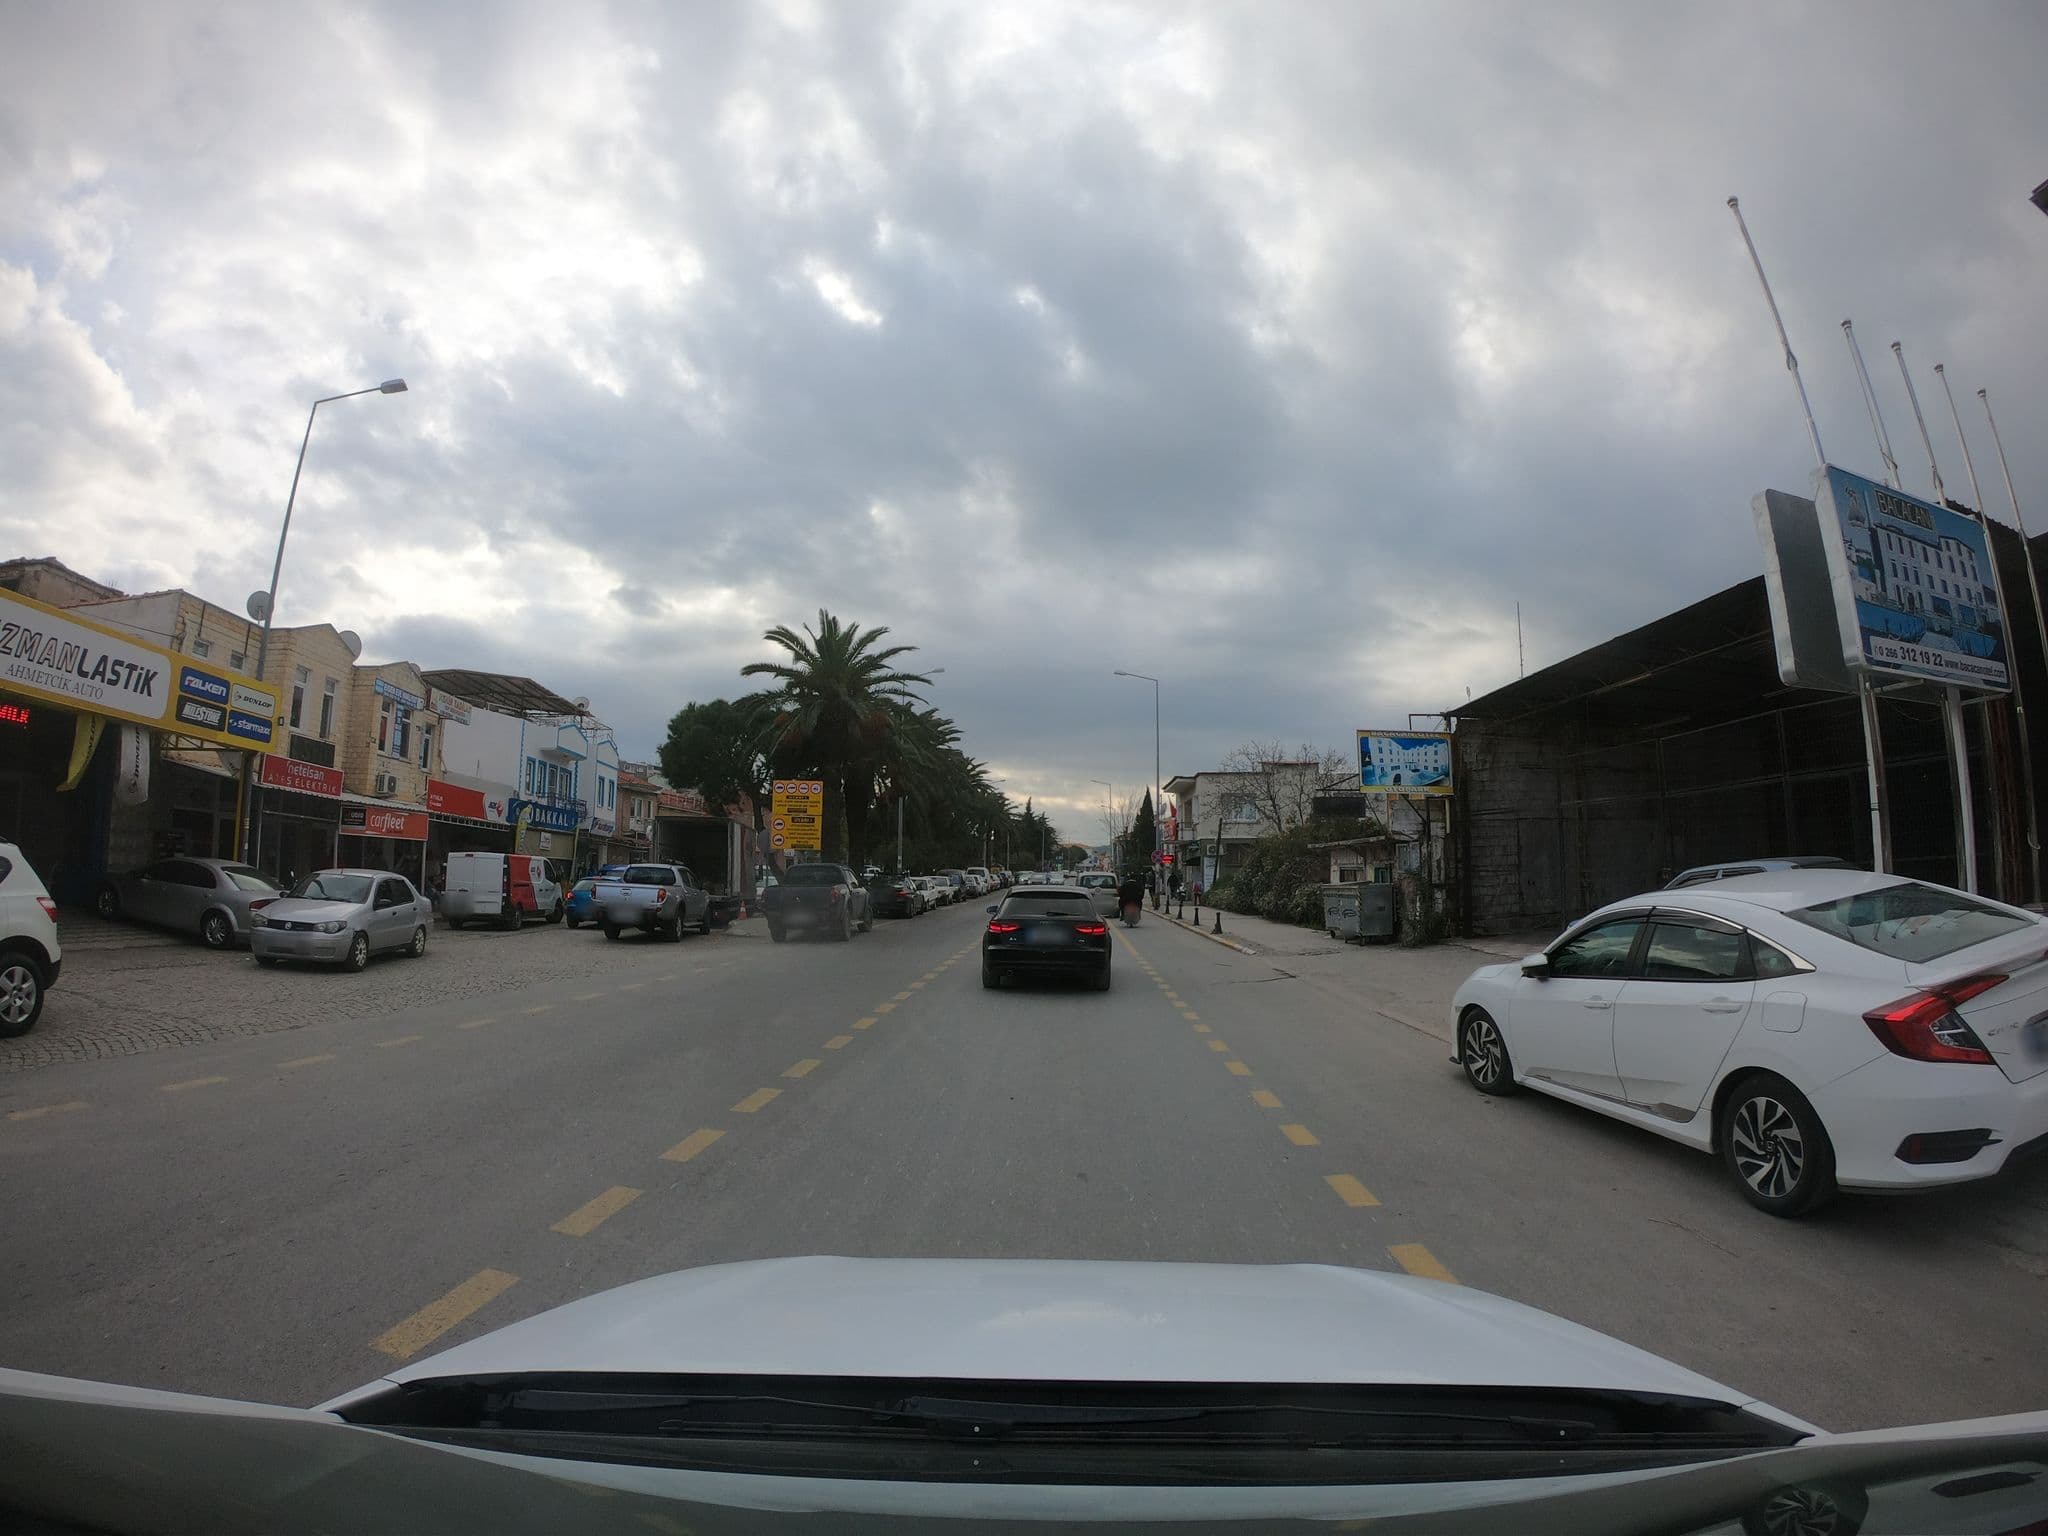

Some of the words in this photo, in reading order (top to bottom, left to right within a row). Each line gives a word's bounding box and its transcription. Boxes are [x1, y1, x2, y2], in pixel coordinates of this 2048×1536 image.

[0, 620, 159, 698] ZMANLASTİK
[1899, 646, 1917, 662] 312
[1919, 649, 1930, 665] 19
[1932, 652, 1944, 667] 22
[71, 681, 104, 700] AUTO
[184, 676, 227, 697] FALKEN
[243, 695, 273, 708] DUNLOP
[238, 719, 271, 736] starmaxx
[370, 813, 405, 832] carfleet
[535, 807, 568, 826] BAKKAL
